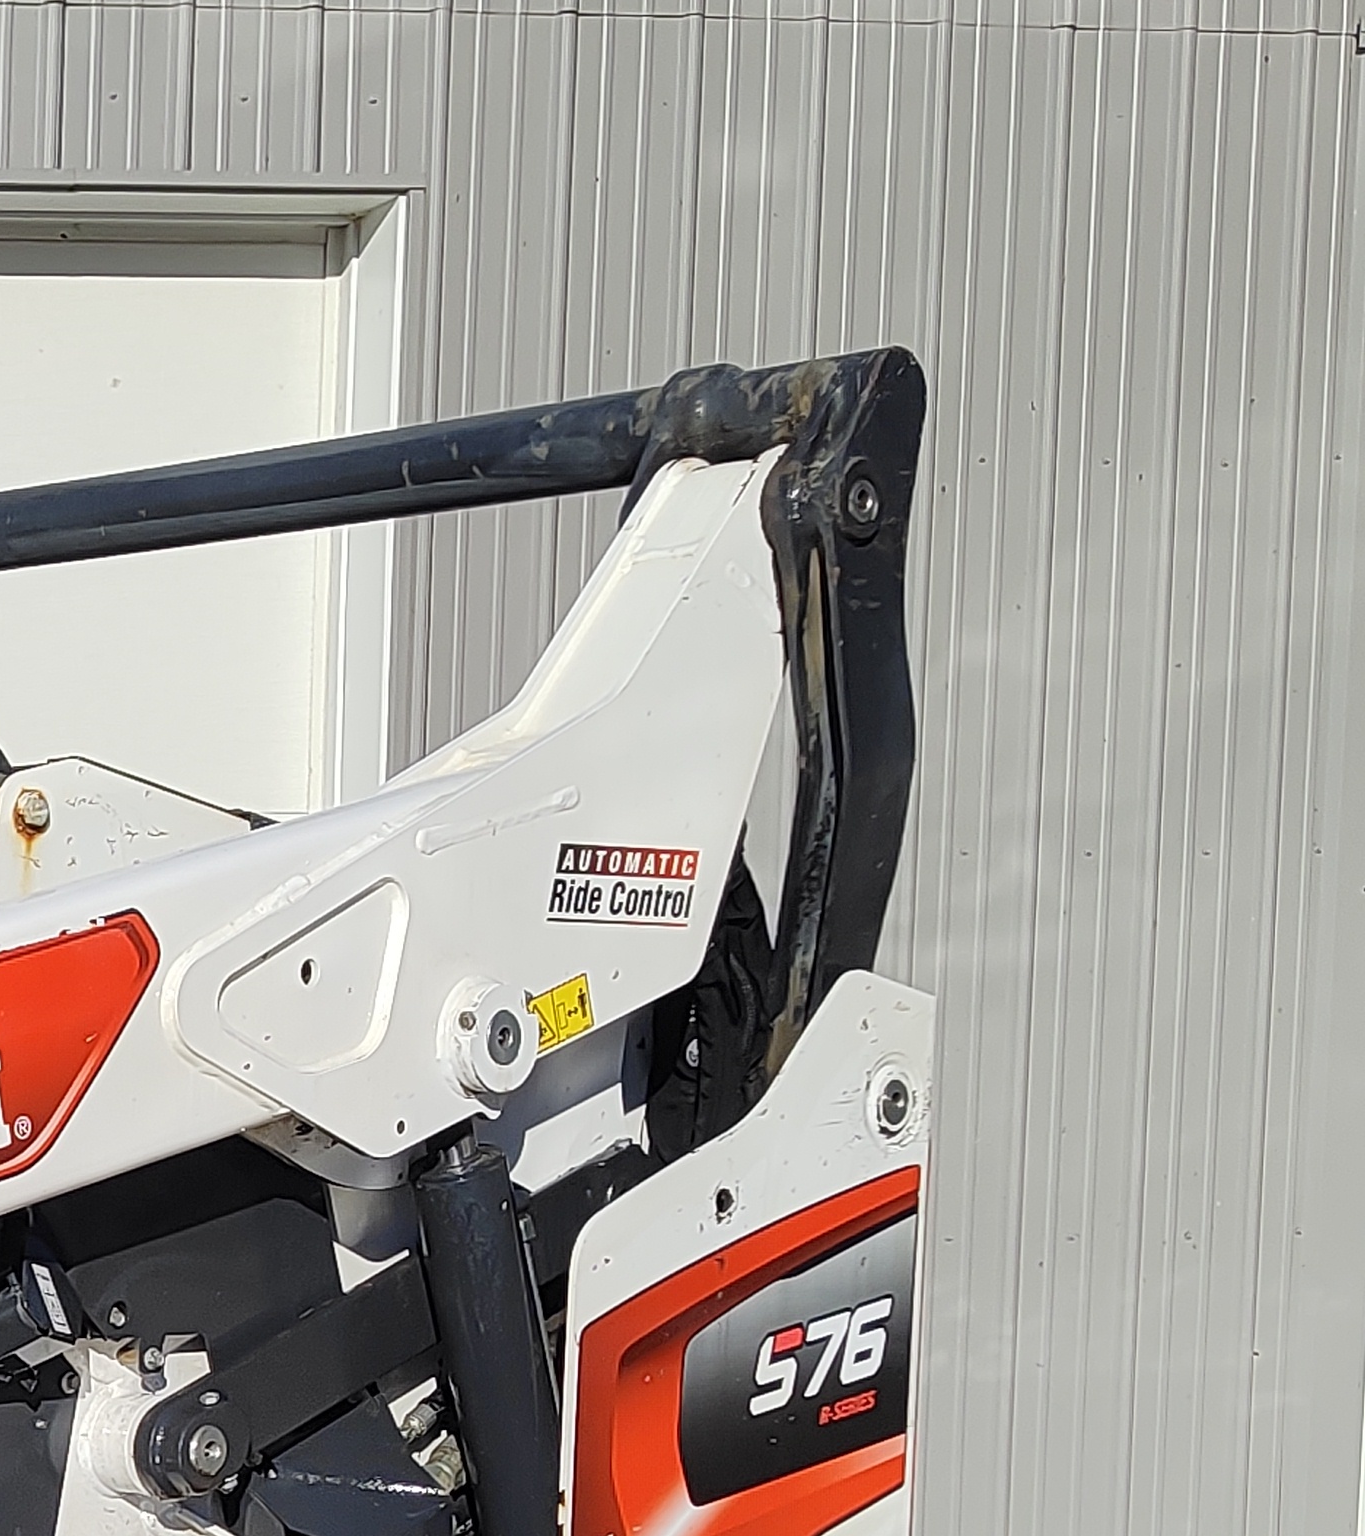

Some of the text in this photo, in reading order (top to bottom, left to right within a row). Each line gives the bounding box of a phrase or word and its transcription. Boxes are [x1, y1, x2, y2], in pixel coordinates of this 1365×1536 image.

[561, 848, 695, 877] AUTOMATIC
[548, 878, 695, 919] Ride Control
[748, 1294, 894, 1417] S76
